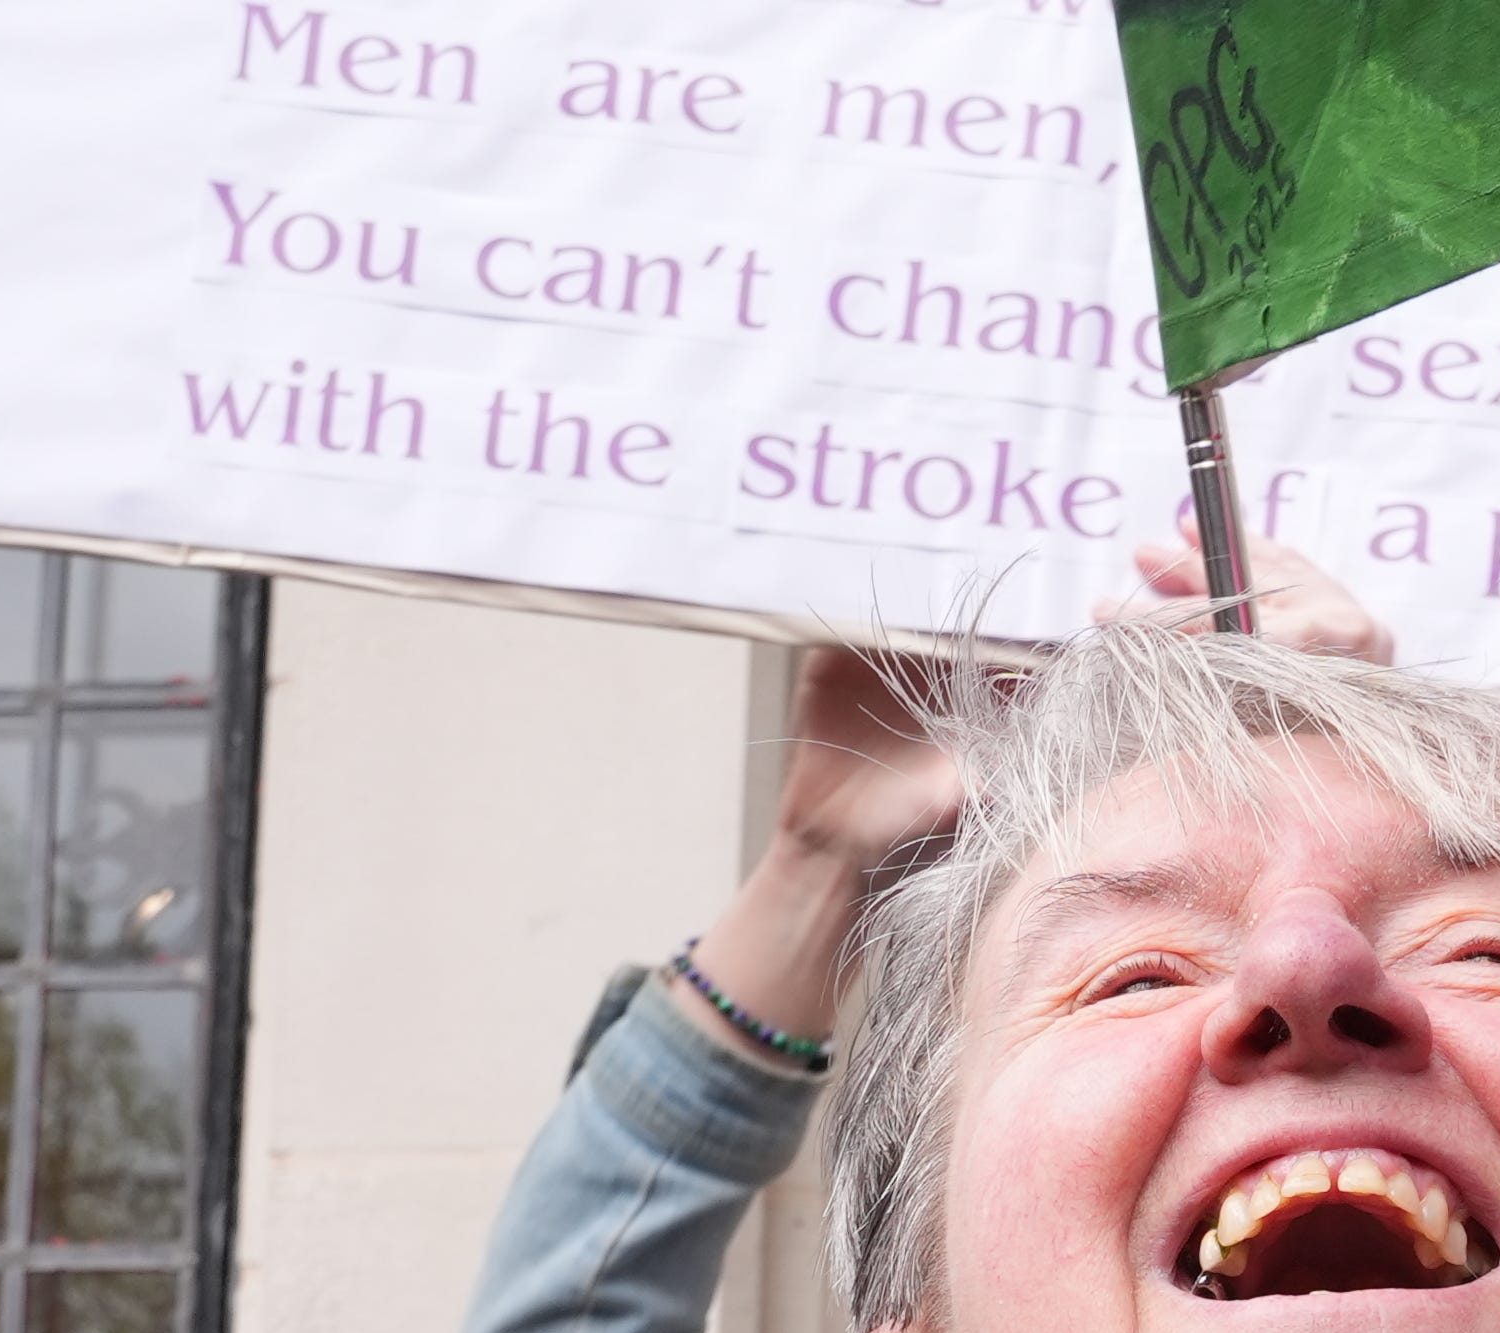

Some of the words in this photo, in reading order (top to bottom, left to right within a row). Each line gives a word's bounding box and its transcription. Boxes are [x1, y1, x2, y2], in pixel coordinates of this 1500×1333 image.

[232, 2, 480, 107] Men
[557, 59, 745, 136] are
[819, 77, 1118, 185] men,
[1143, 23, 1277, 299] GPG
[207, 180, 421, 288] You
[181, 359, 427, 462] with
[483, 388, 674, 488] the
[737, 422, 1123, 540] stroke
[1176, 469, 1308, 541] f
[1367, 502, 1431, 565] a
